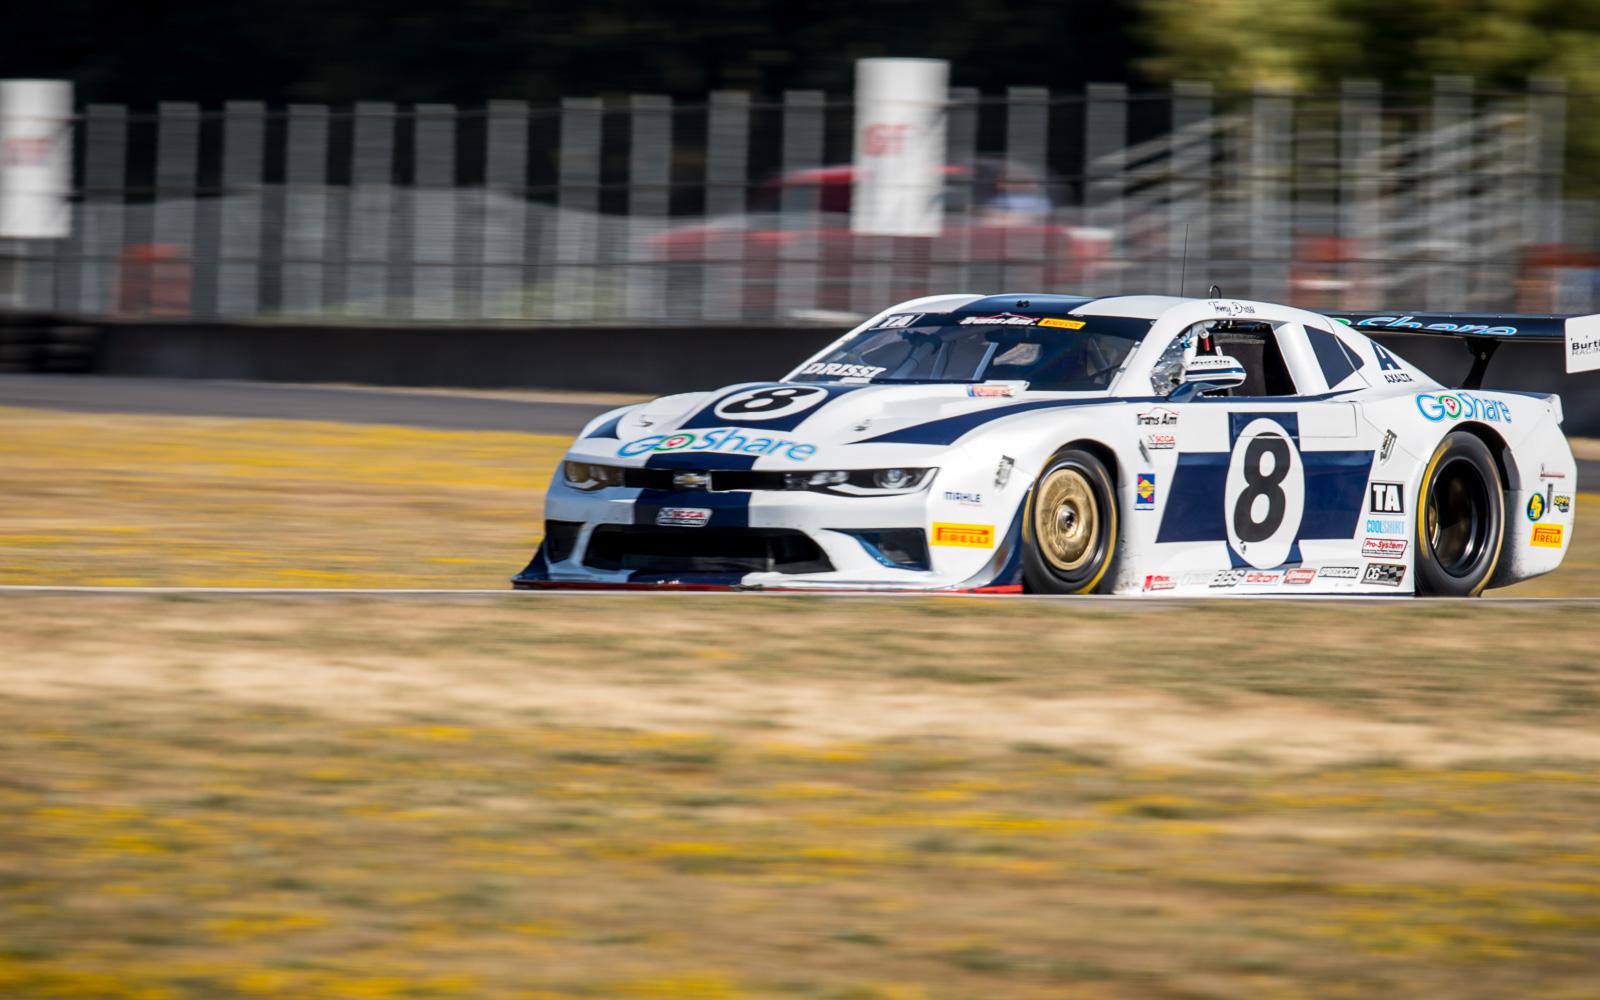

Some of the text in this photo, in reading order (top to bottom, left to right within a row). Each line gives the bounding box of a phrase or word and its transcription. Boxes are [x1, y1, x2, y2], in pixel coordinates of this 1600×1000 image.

[801, 363, 886, 377] DRISSI
[1384, 374, 1414, 384] AXALTA
[721, 388, 820, 413] 8
[1137, 413, 1177, 425] Trans Am
[1233, 431, 1291, 543] 8
[1373, 485, 1401, 511] TA
[937, 528, 989, 544] PIRELLI
[1534, 528, 1561, 543] PIRELLI
[1209, 570, 1247, 588] BBS
